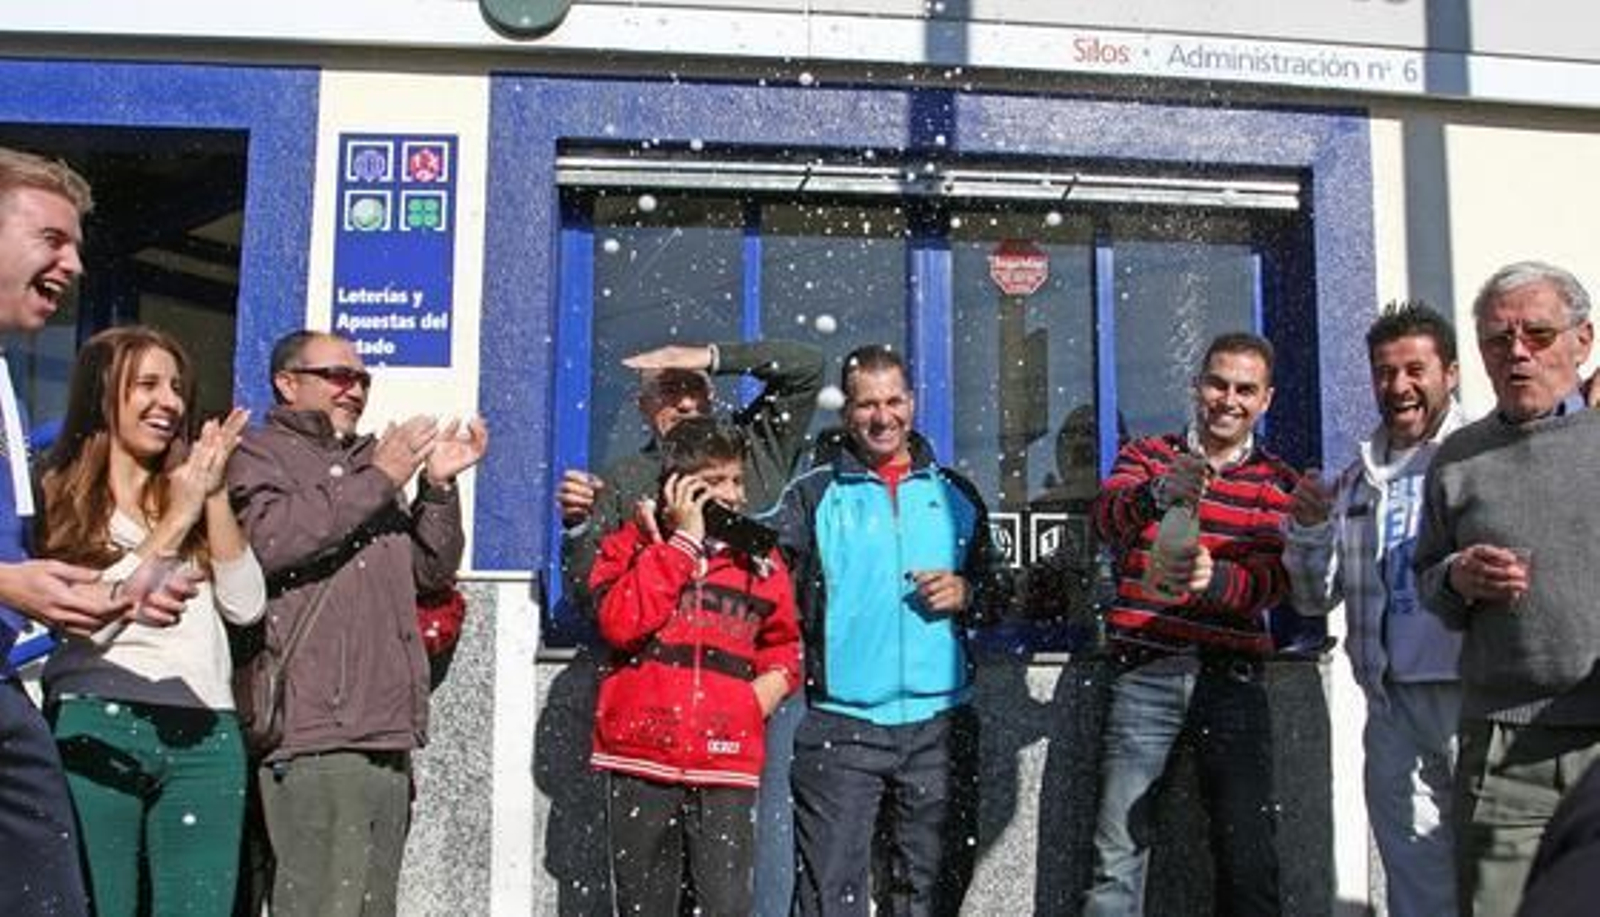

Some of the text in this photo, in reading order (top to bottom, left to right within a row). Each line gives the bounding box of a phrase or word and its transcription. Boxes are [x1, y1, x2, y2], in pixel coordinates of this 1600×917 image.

[1073, 37, 1130, 64] Silos
[1167, 44, 1360, 80] Administración
[1404, 58, 1418, 83] 6
[337, 285, 423, 308] Loterías y
[336, 312, 448, 333] Apuestas del
